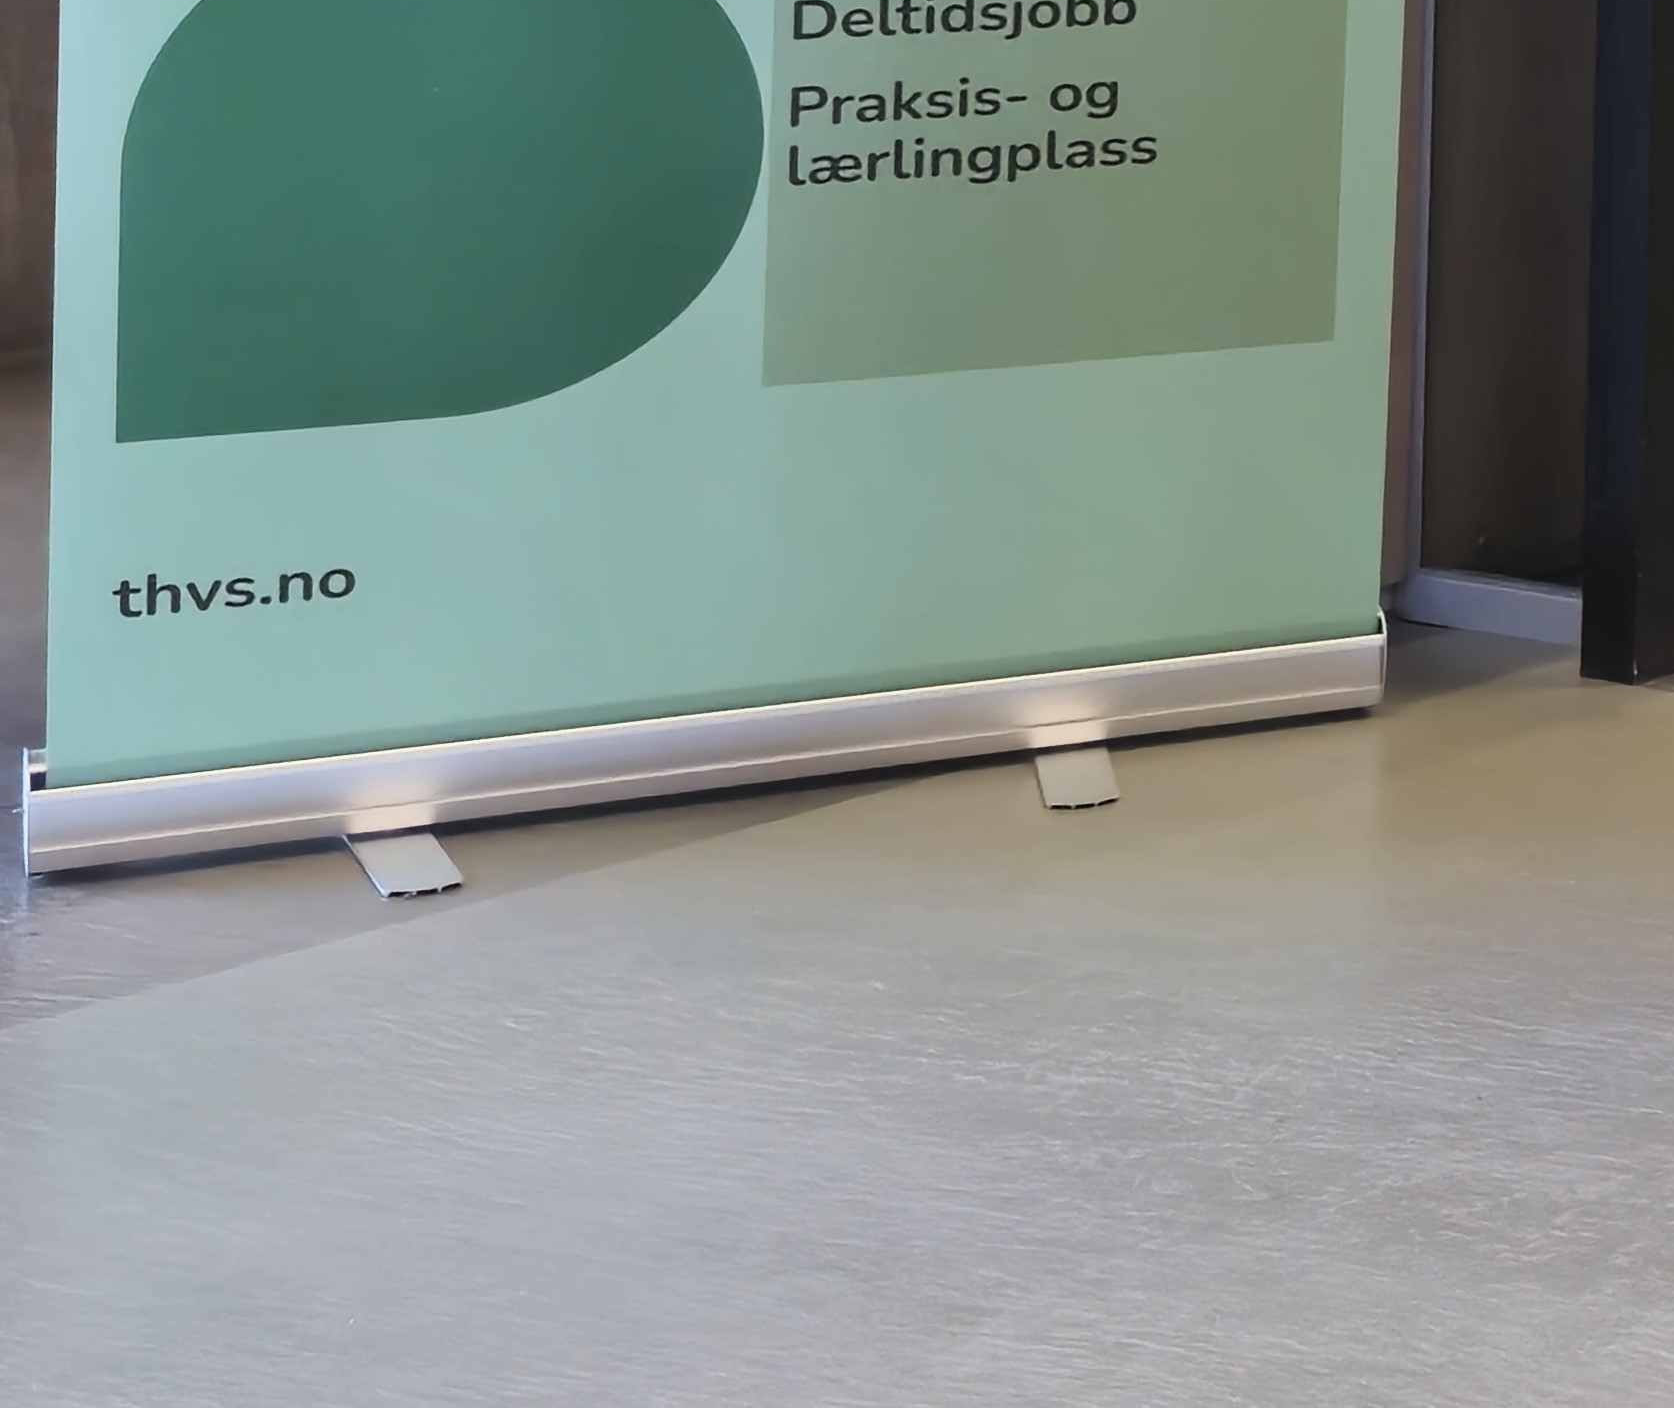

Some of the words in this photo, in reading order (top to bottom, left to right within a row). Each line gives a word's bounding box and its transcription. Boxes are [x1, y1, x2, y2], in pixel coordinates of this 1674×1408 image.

[790, 77, 1028, 126] Praksis-
[1049, 80, 1119, 119] og
[788, 122, 1158, 186] lærlingplass
[111, 568, 356, 618] thvs.no
